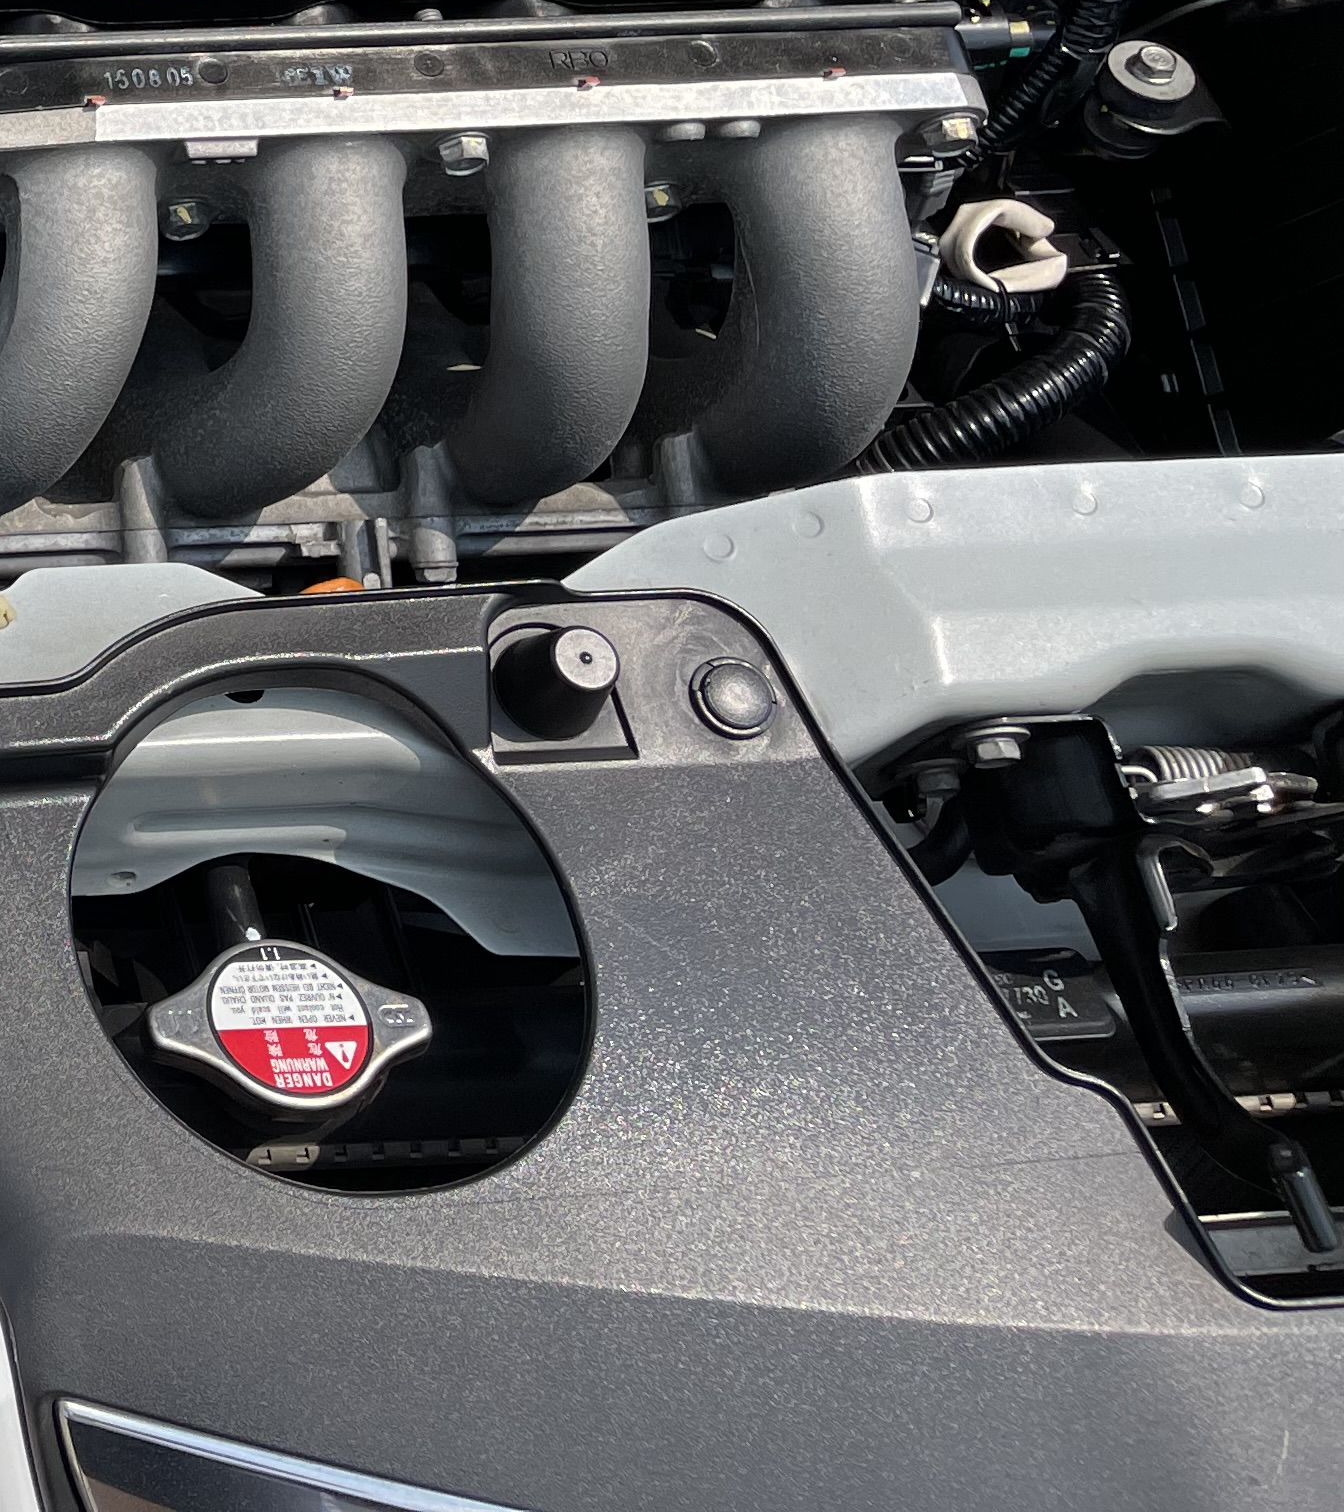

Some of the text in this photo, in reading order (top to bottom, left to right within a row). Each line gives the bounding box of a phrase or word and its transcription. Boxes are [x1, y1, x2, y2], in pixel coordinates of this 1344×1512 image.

[259, 946, 281, 961] 1.1
[1043, 969, 1065, 991] G
[1057, 996, 1079, 1019] A
[298, 1015, 318, 1024] OPEN
[270, 1057, 329, 1072] WARNUNG
[274, 1073, 333, 1088] DANGER
